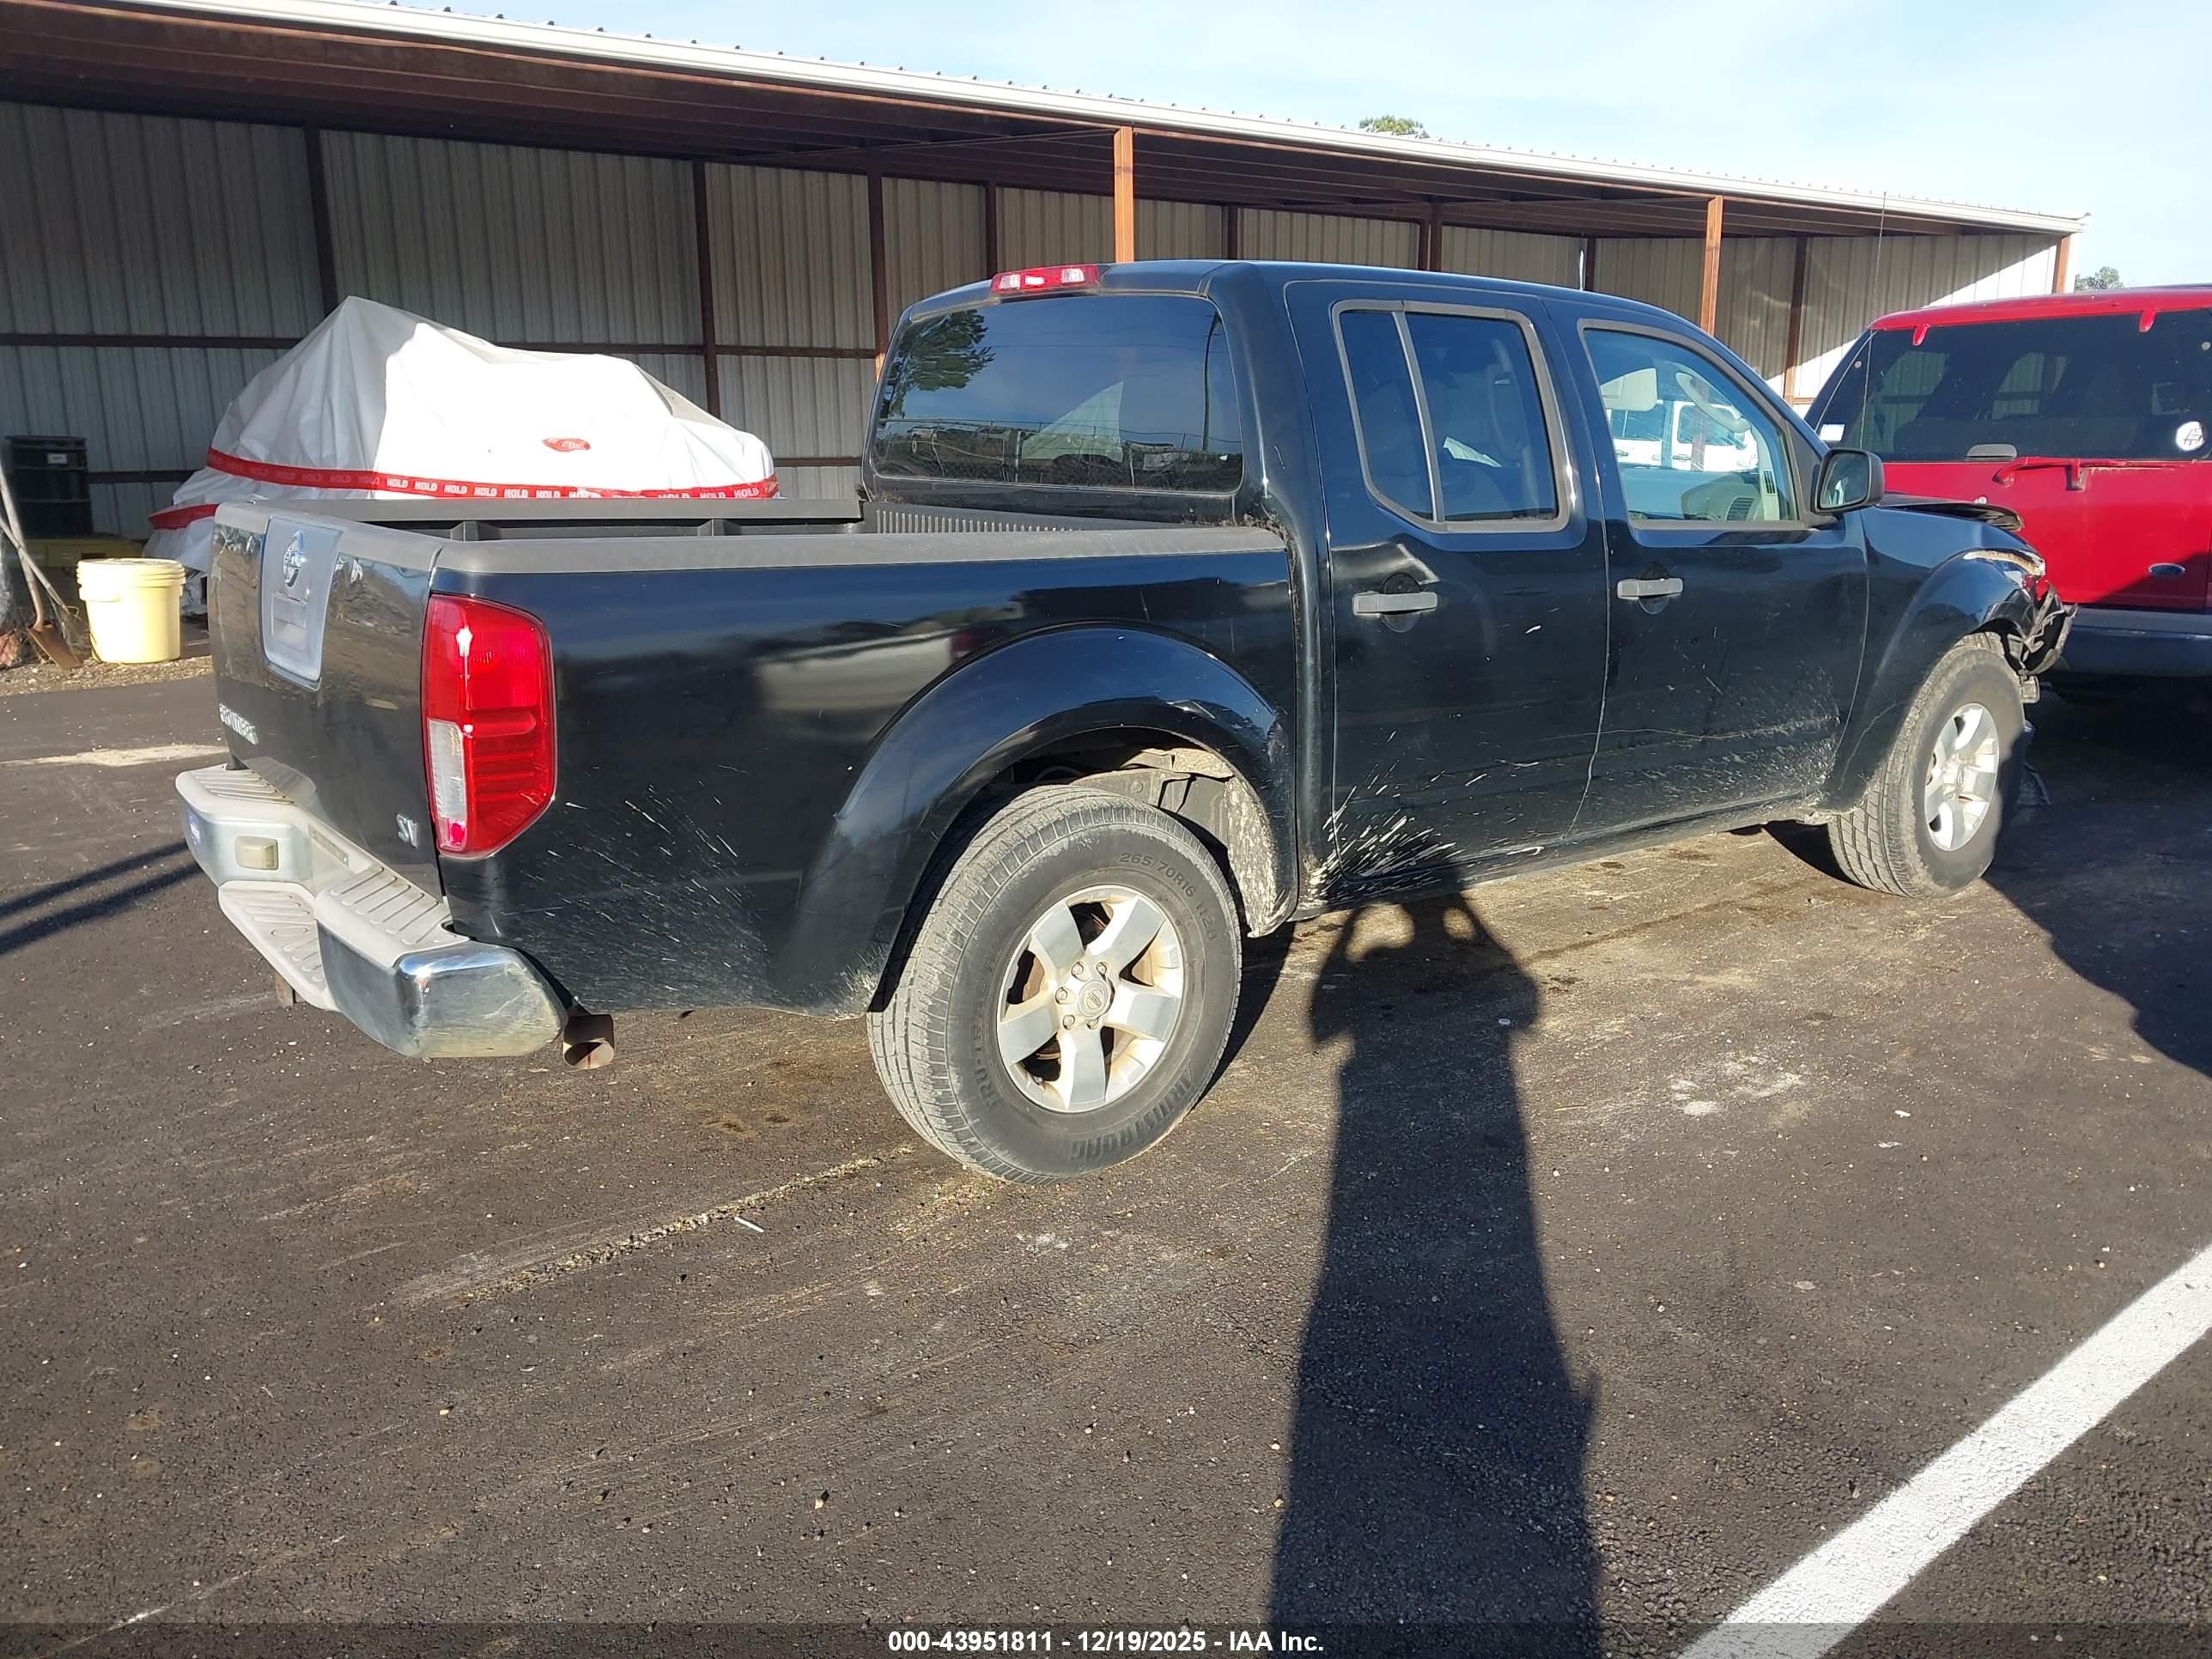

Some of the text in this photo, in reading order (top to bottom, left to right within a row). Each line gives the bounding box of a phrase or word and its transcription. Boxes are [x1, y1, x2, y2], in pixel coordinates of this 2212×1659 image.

[386, 477, 409, 489] HOLD
[415, 480, 438, 492] HOLD
[444, 483, 468, 495] HOLD
[474, 486, 498, 497] HOLD
[504, 489, 529, 498] HOLD
[734, 487, 759, 498] HOLD
[1119, 852, 1196, 897] 265/70R16
